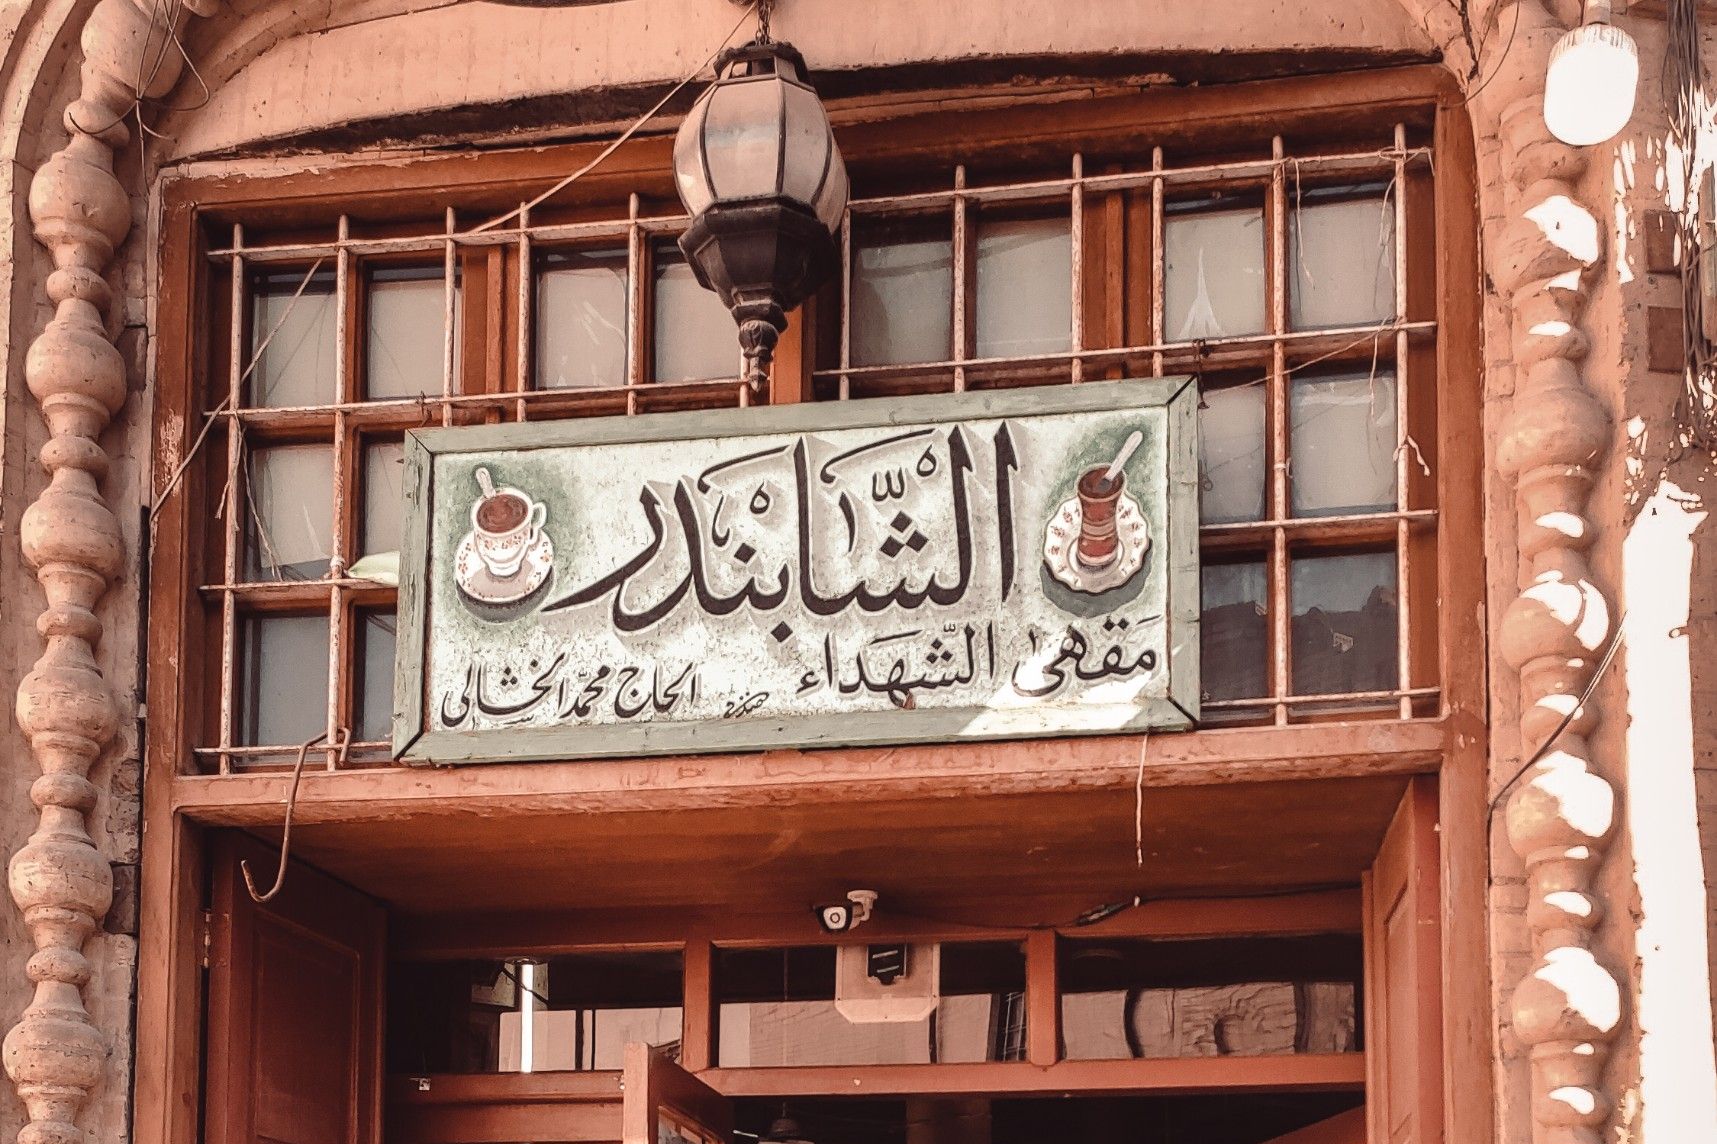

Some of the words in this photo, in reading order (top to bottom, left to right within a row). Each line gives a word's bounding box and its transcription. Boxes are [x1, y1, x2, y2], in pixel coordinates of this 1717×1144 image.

[558, 663, 612, 719] محمد
[614, 661, 697, 719] الحاج
[796, 621, 995, 709] الشهداء
